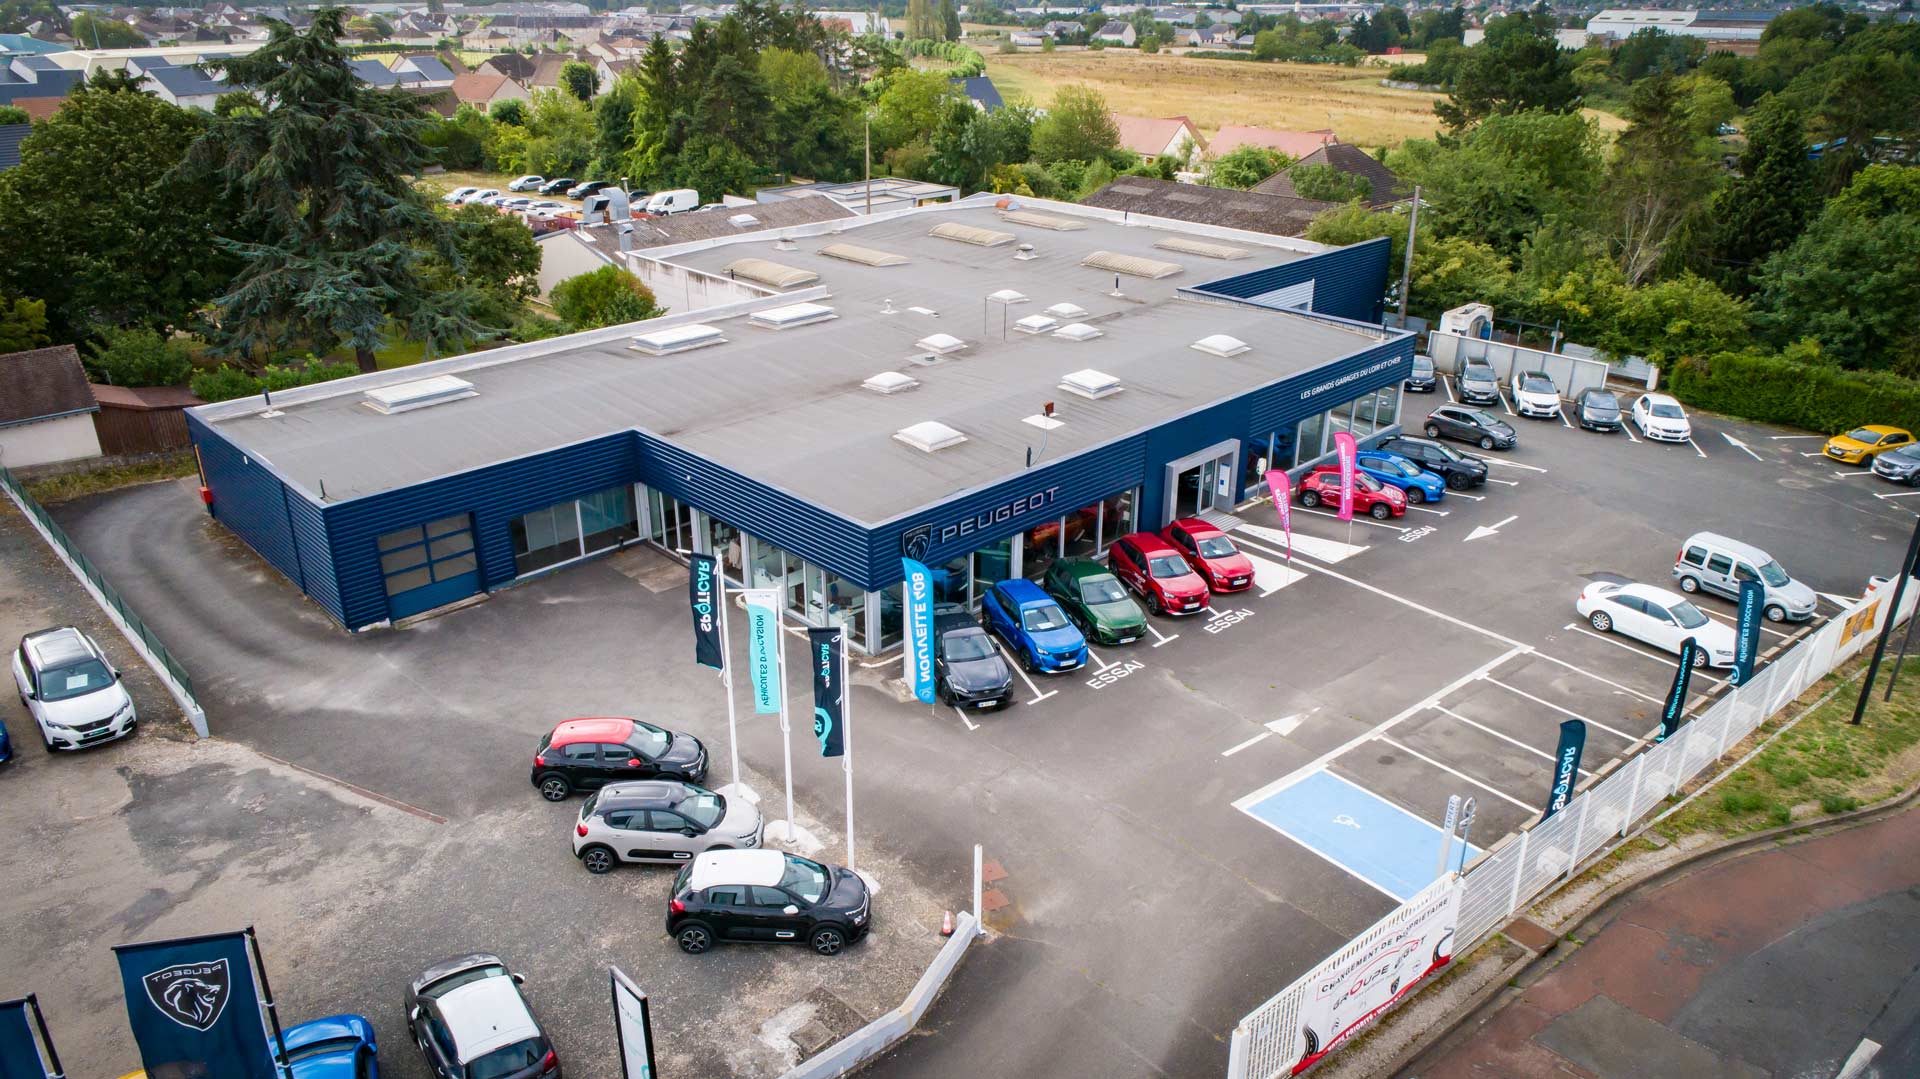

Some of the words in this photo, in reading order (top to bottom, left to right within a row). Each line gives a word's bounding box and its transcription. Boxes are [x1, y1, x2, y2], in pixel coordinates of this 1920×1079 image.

[1300, 390, 1311, 400] LES
[1311, 381, 1335, 396] GRANDS
[1334, 372, 1360, 387] GARAGES
[941, 486, 1060, 544] PEUGEOT
[1397, 525, 1438, 543] ESSAI
[1203, 607, 1256, 635] ESSAI
[1085, 659, 1146, 690] ESSAI
[1321, 947, 1379, 993] CHANGEMENT
[1380, 937, 1393, 949] DE
[1332, 963, 1390, 1010] GROUPE
